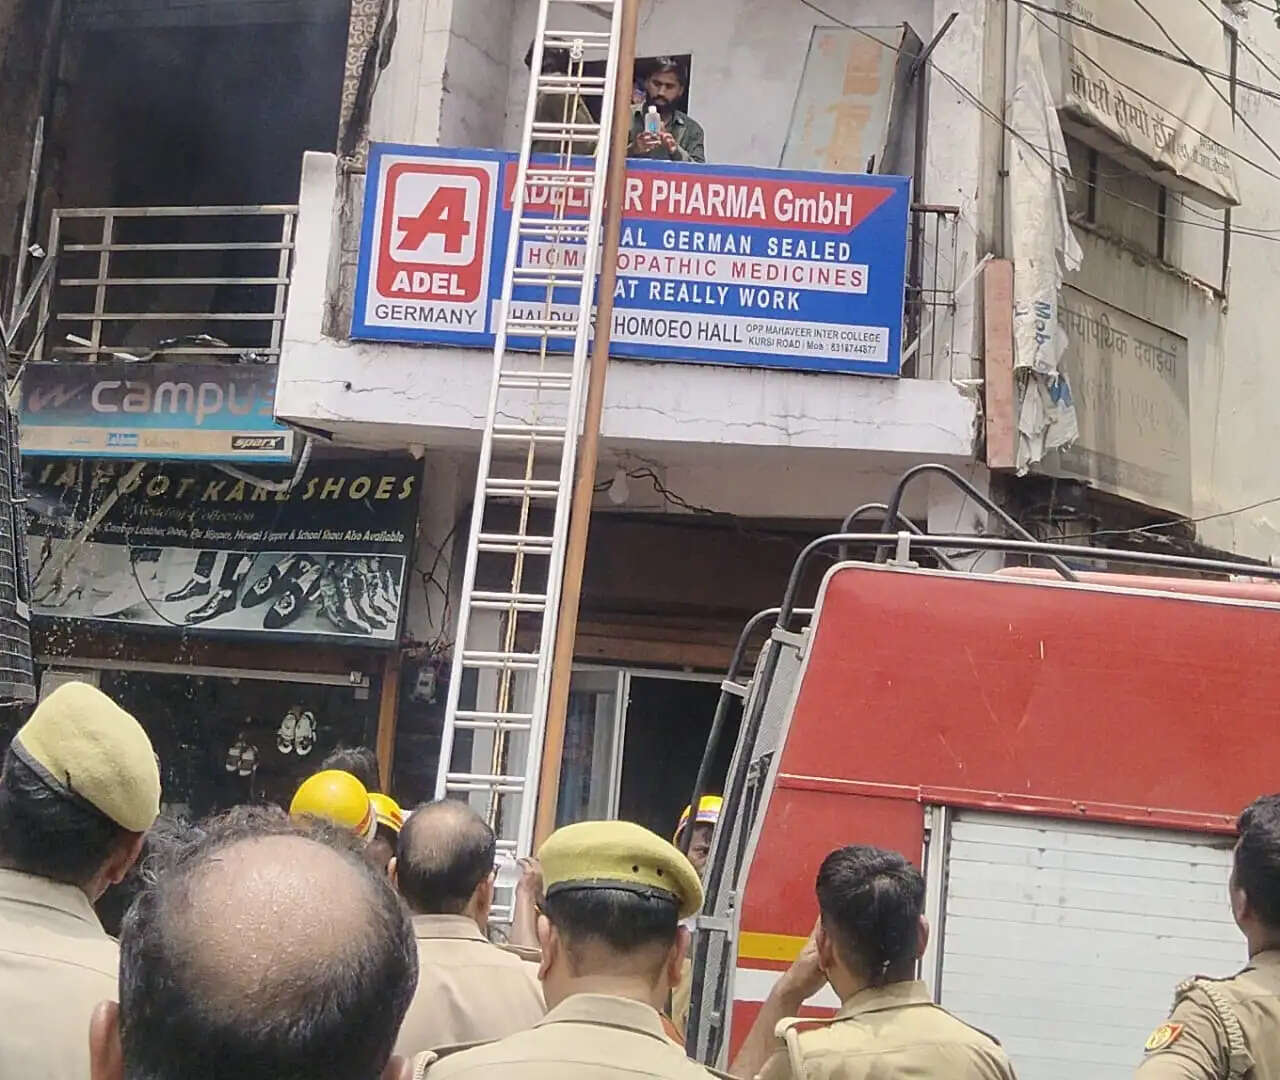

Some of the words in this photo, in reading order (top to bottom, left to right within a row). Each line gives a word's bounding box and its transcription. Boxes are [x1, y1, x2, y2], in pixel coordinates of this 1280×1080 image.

[509, 174, 643, 212] ADELR
[651, 180, 766, 221] PHARMA
[774, 187, 853, 226] GmbH
[663, 229, 752, 254] GERMAN
[767, 237, 851, 261] SEALED
[529, 246, 720, 280] HOMOPATHIC
[730, 260, 864, 288] MEDICINES
[390, 270, 466, 296] ADEL
[649, 281, 731, 307] REALLY
[739, 289, 801, 311] WORK
[375, 304, 478, 326] GERMANY
[614, 314, 692, 339] HOMOEO
[697, 322, 742, 344] HALL
[765, 325, 812, 338] MAHAVEER
[814, 329, 839, 340] INTER
[840, 331, 881, 343] COLLEGE
[776, 338, 801, 349] ROAD
[232, 437, 280, 451] sparx
[302, 474, 417, 501] SHOES
[344, 529, 362, 542] Also
[362, 530, 405, 544] Available
